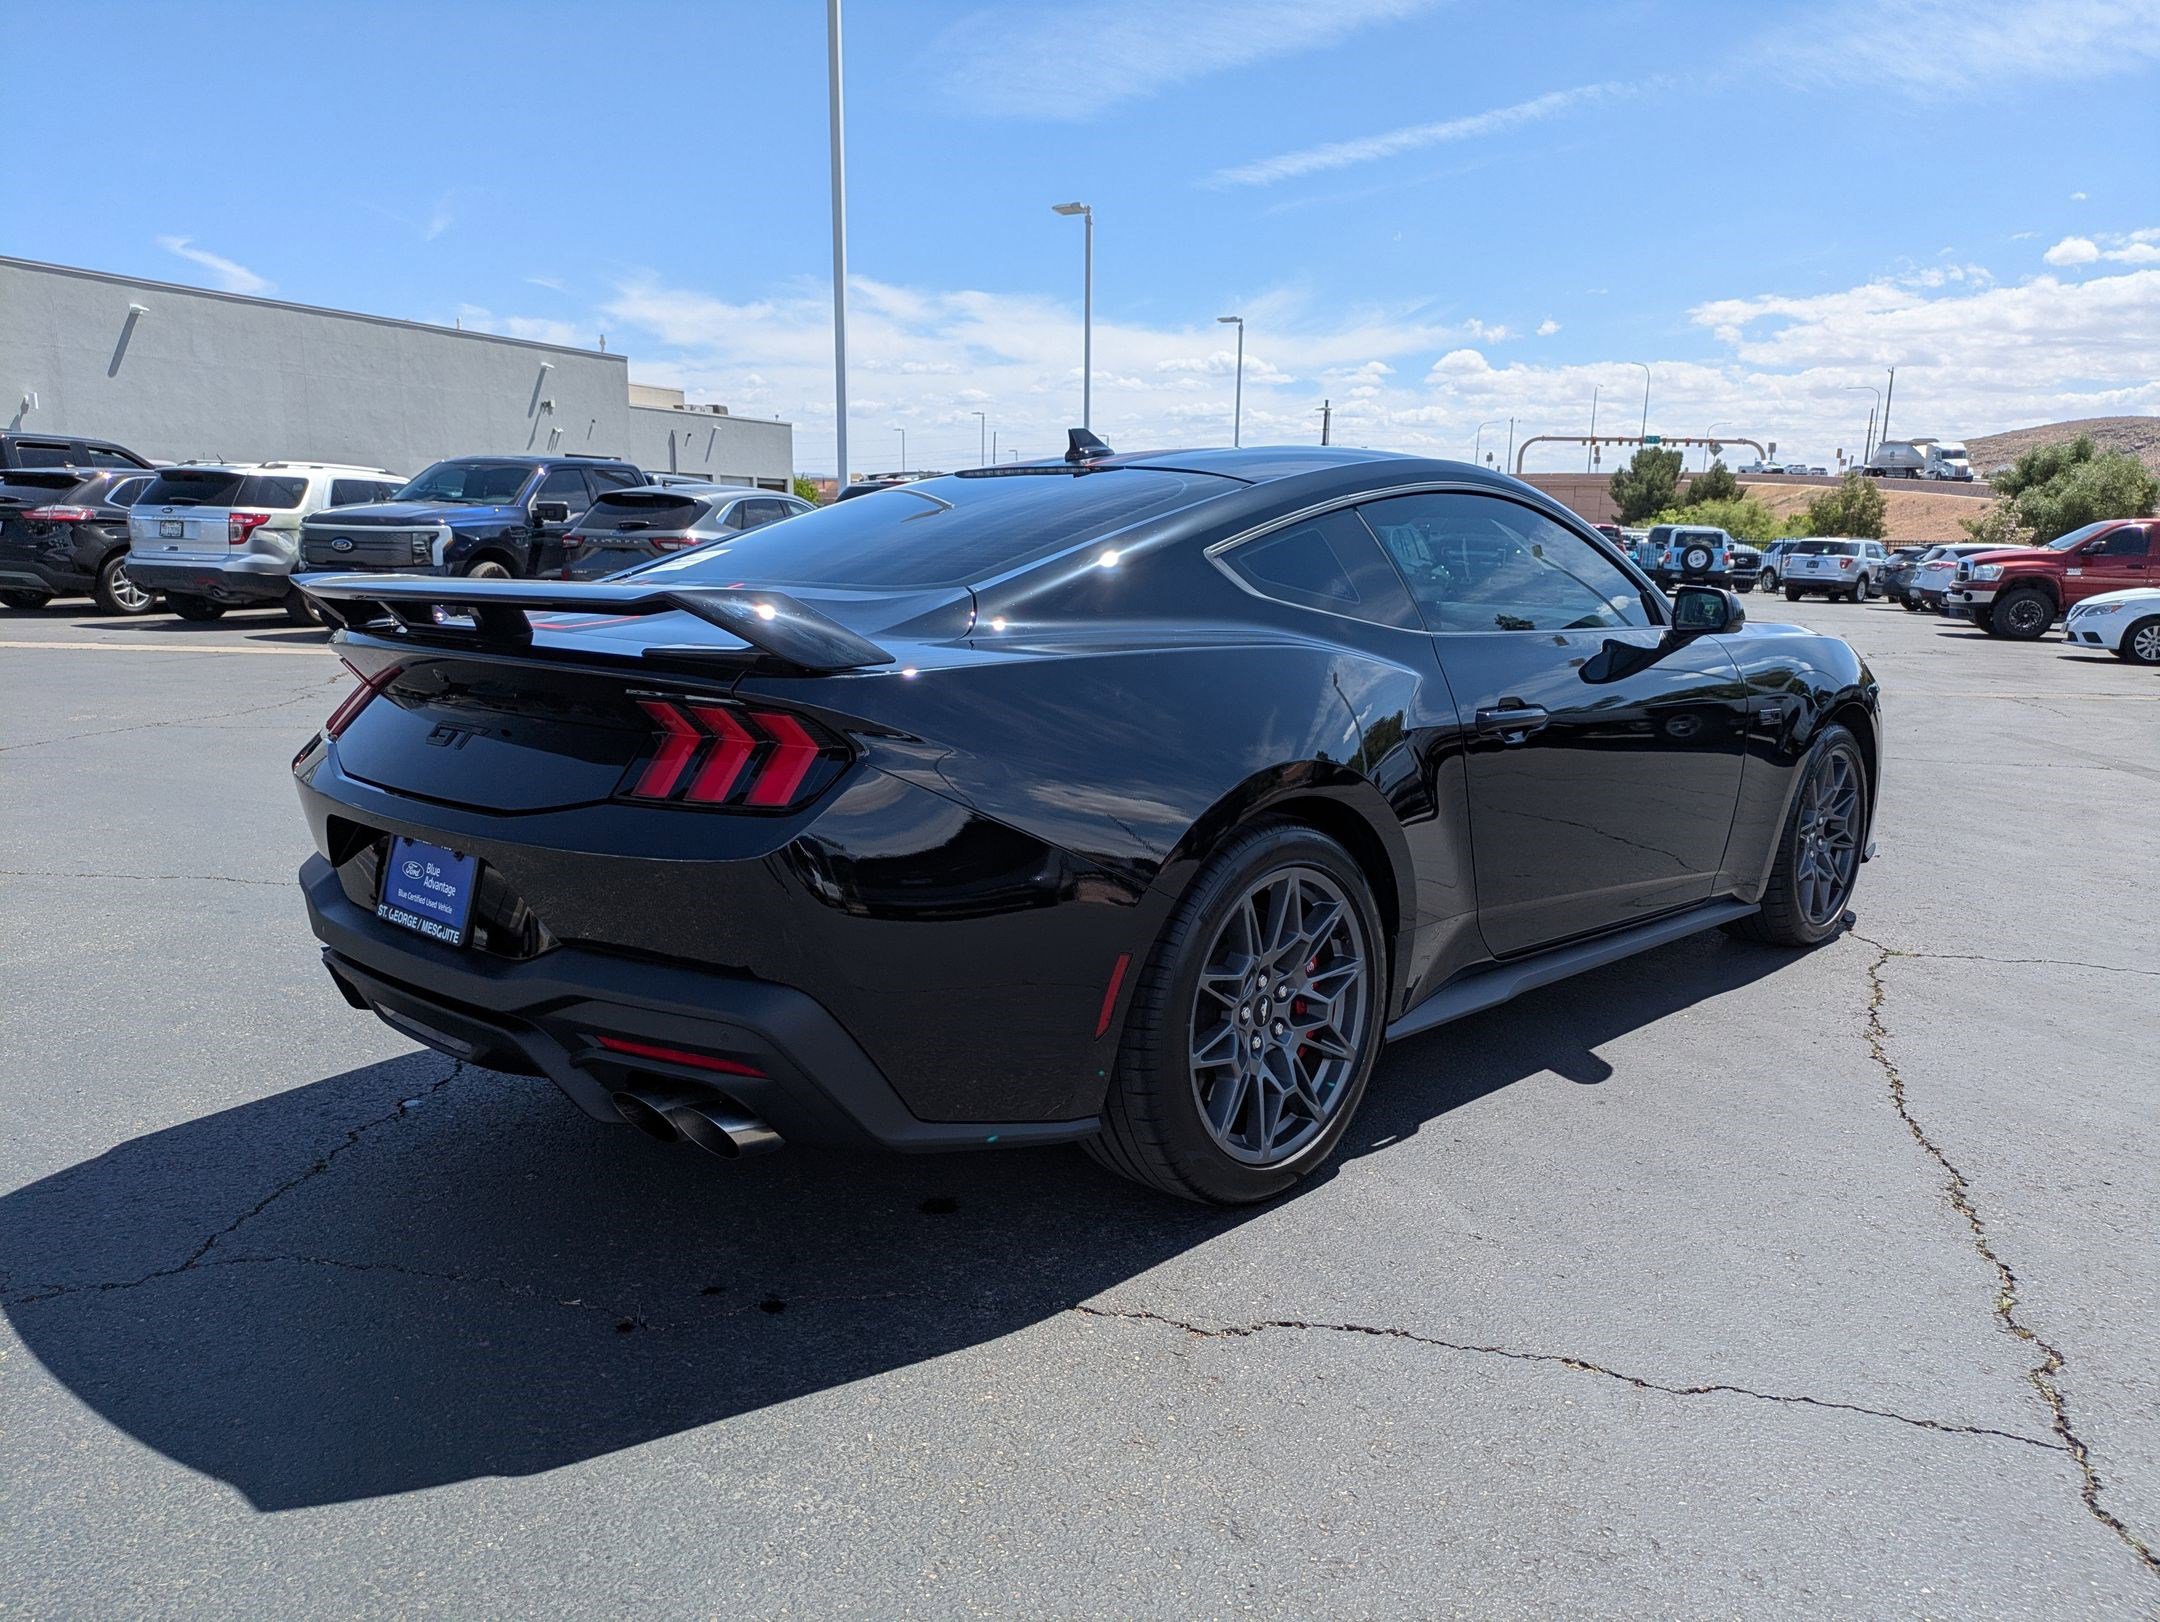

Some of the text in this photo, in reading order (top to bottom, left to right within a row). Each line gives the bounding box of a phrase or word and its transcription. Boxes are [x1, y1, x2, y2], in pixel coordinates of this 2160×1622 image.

[425, 720, 491, 750] GT
[404, 862, 421, 877] Ford
[426, 863, 440, 877] Blue
[423, 876, 456, 897] Advantage
[398, 888, 453, 914] Blue Certified Used Vehicle
[377, 904, 387, 917] ST.
[388, 907, 418, 928] GEORGE
